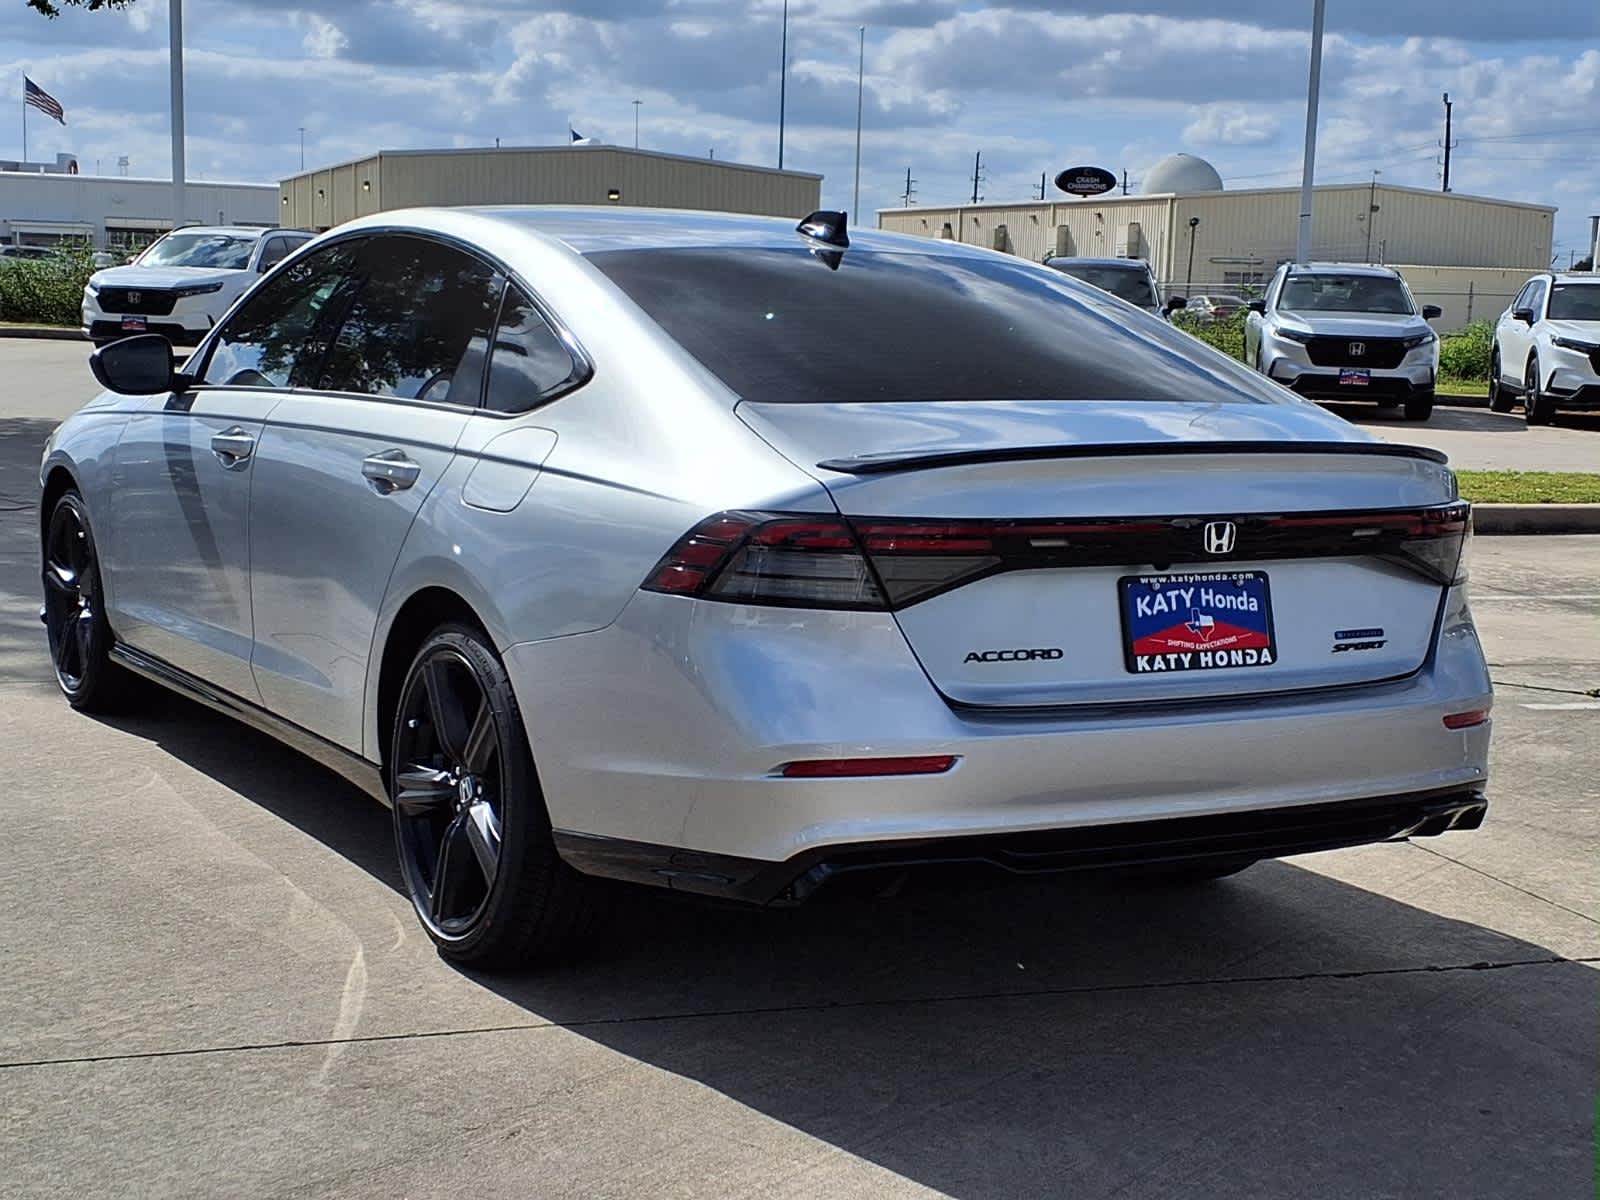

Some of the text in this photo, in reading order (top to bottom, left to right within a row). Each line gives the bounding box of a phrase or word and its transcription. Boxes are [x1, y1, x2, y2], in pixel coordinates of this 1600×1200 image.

[1140, 573, 1254, 584] www.katyhonda.com
[1136, 587, 1258, 618] KATY Honda
[963, 648, 1063, 663] ACCORD
[1136, 648, 1272, 672] KATY HONDA
